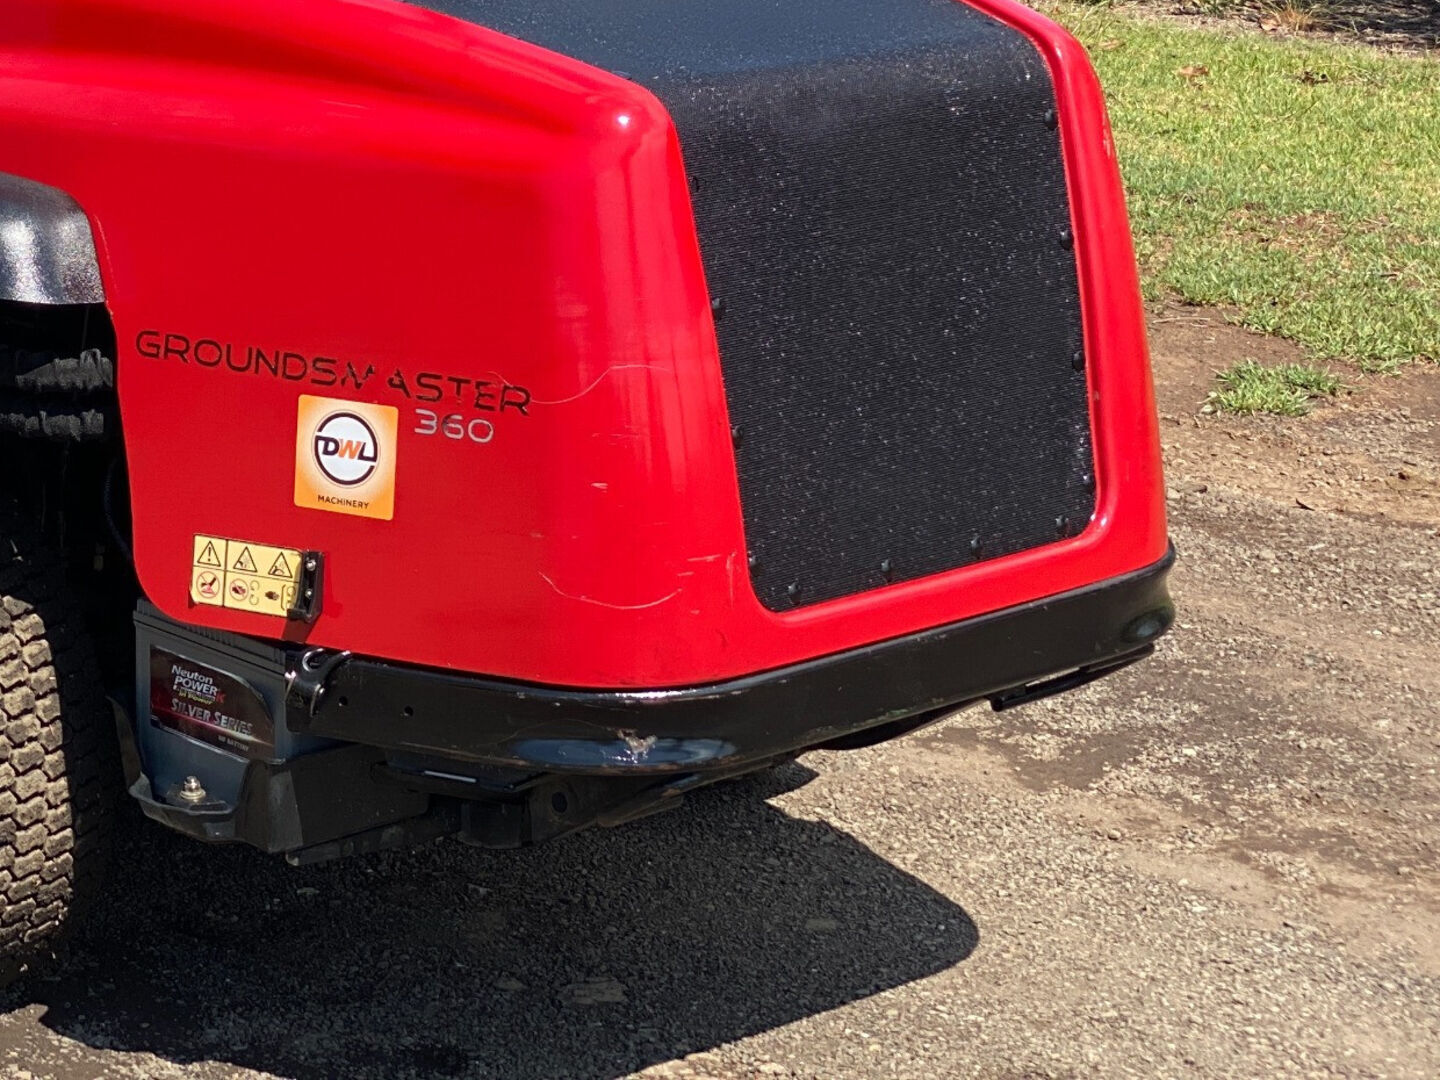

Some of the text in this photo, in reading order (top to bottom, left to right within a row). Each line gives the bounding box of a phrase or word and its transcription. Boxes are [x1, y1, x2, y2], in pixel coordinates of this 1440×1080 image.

[135, 329, 532, 417] GROUNDSMASTER
[413, 408, 495, 444] 360
[316, 434, 378, 463] DWL
[317, 494, 370, 510] MACHINERY
[171, 664, 213, 685] Neuton
[174, 676, 218, 696] POWER
[171, 698, 253, 735] SILVER SERIES
